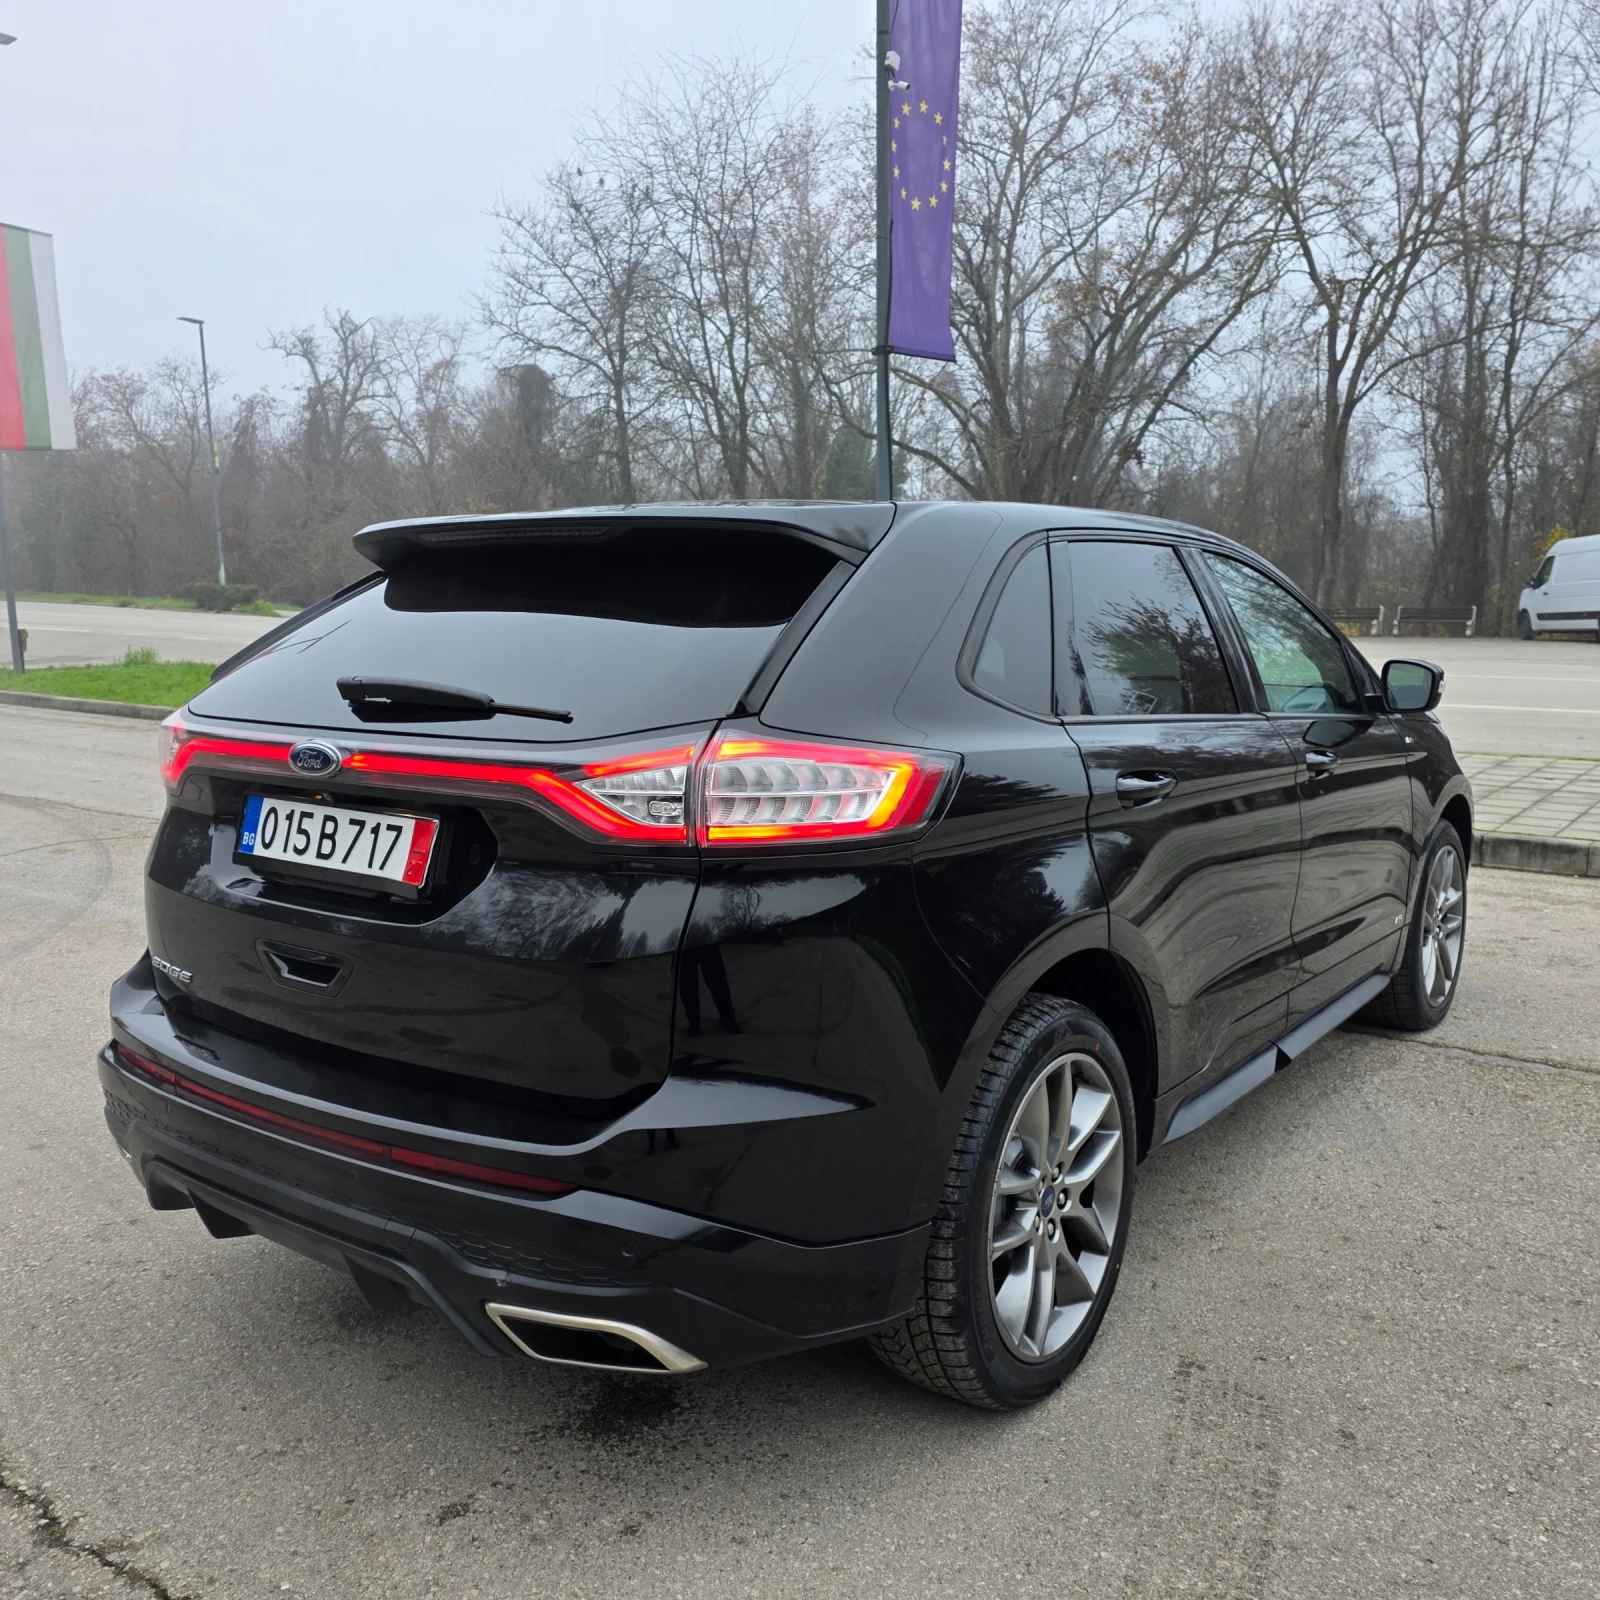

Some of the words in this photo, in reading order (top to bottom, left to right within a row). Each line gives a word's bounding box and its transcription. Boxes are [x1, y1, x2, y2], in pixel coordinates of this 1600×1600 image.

[297, 749, 324, 769] Ford
[242, 832, 255, 846] BG
[152, 956, 192, 982] EDGE
